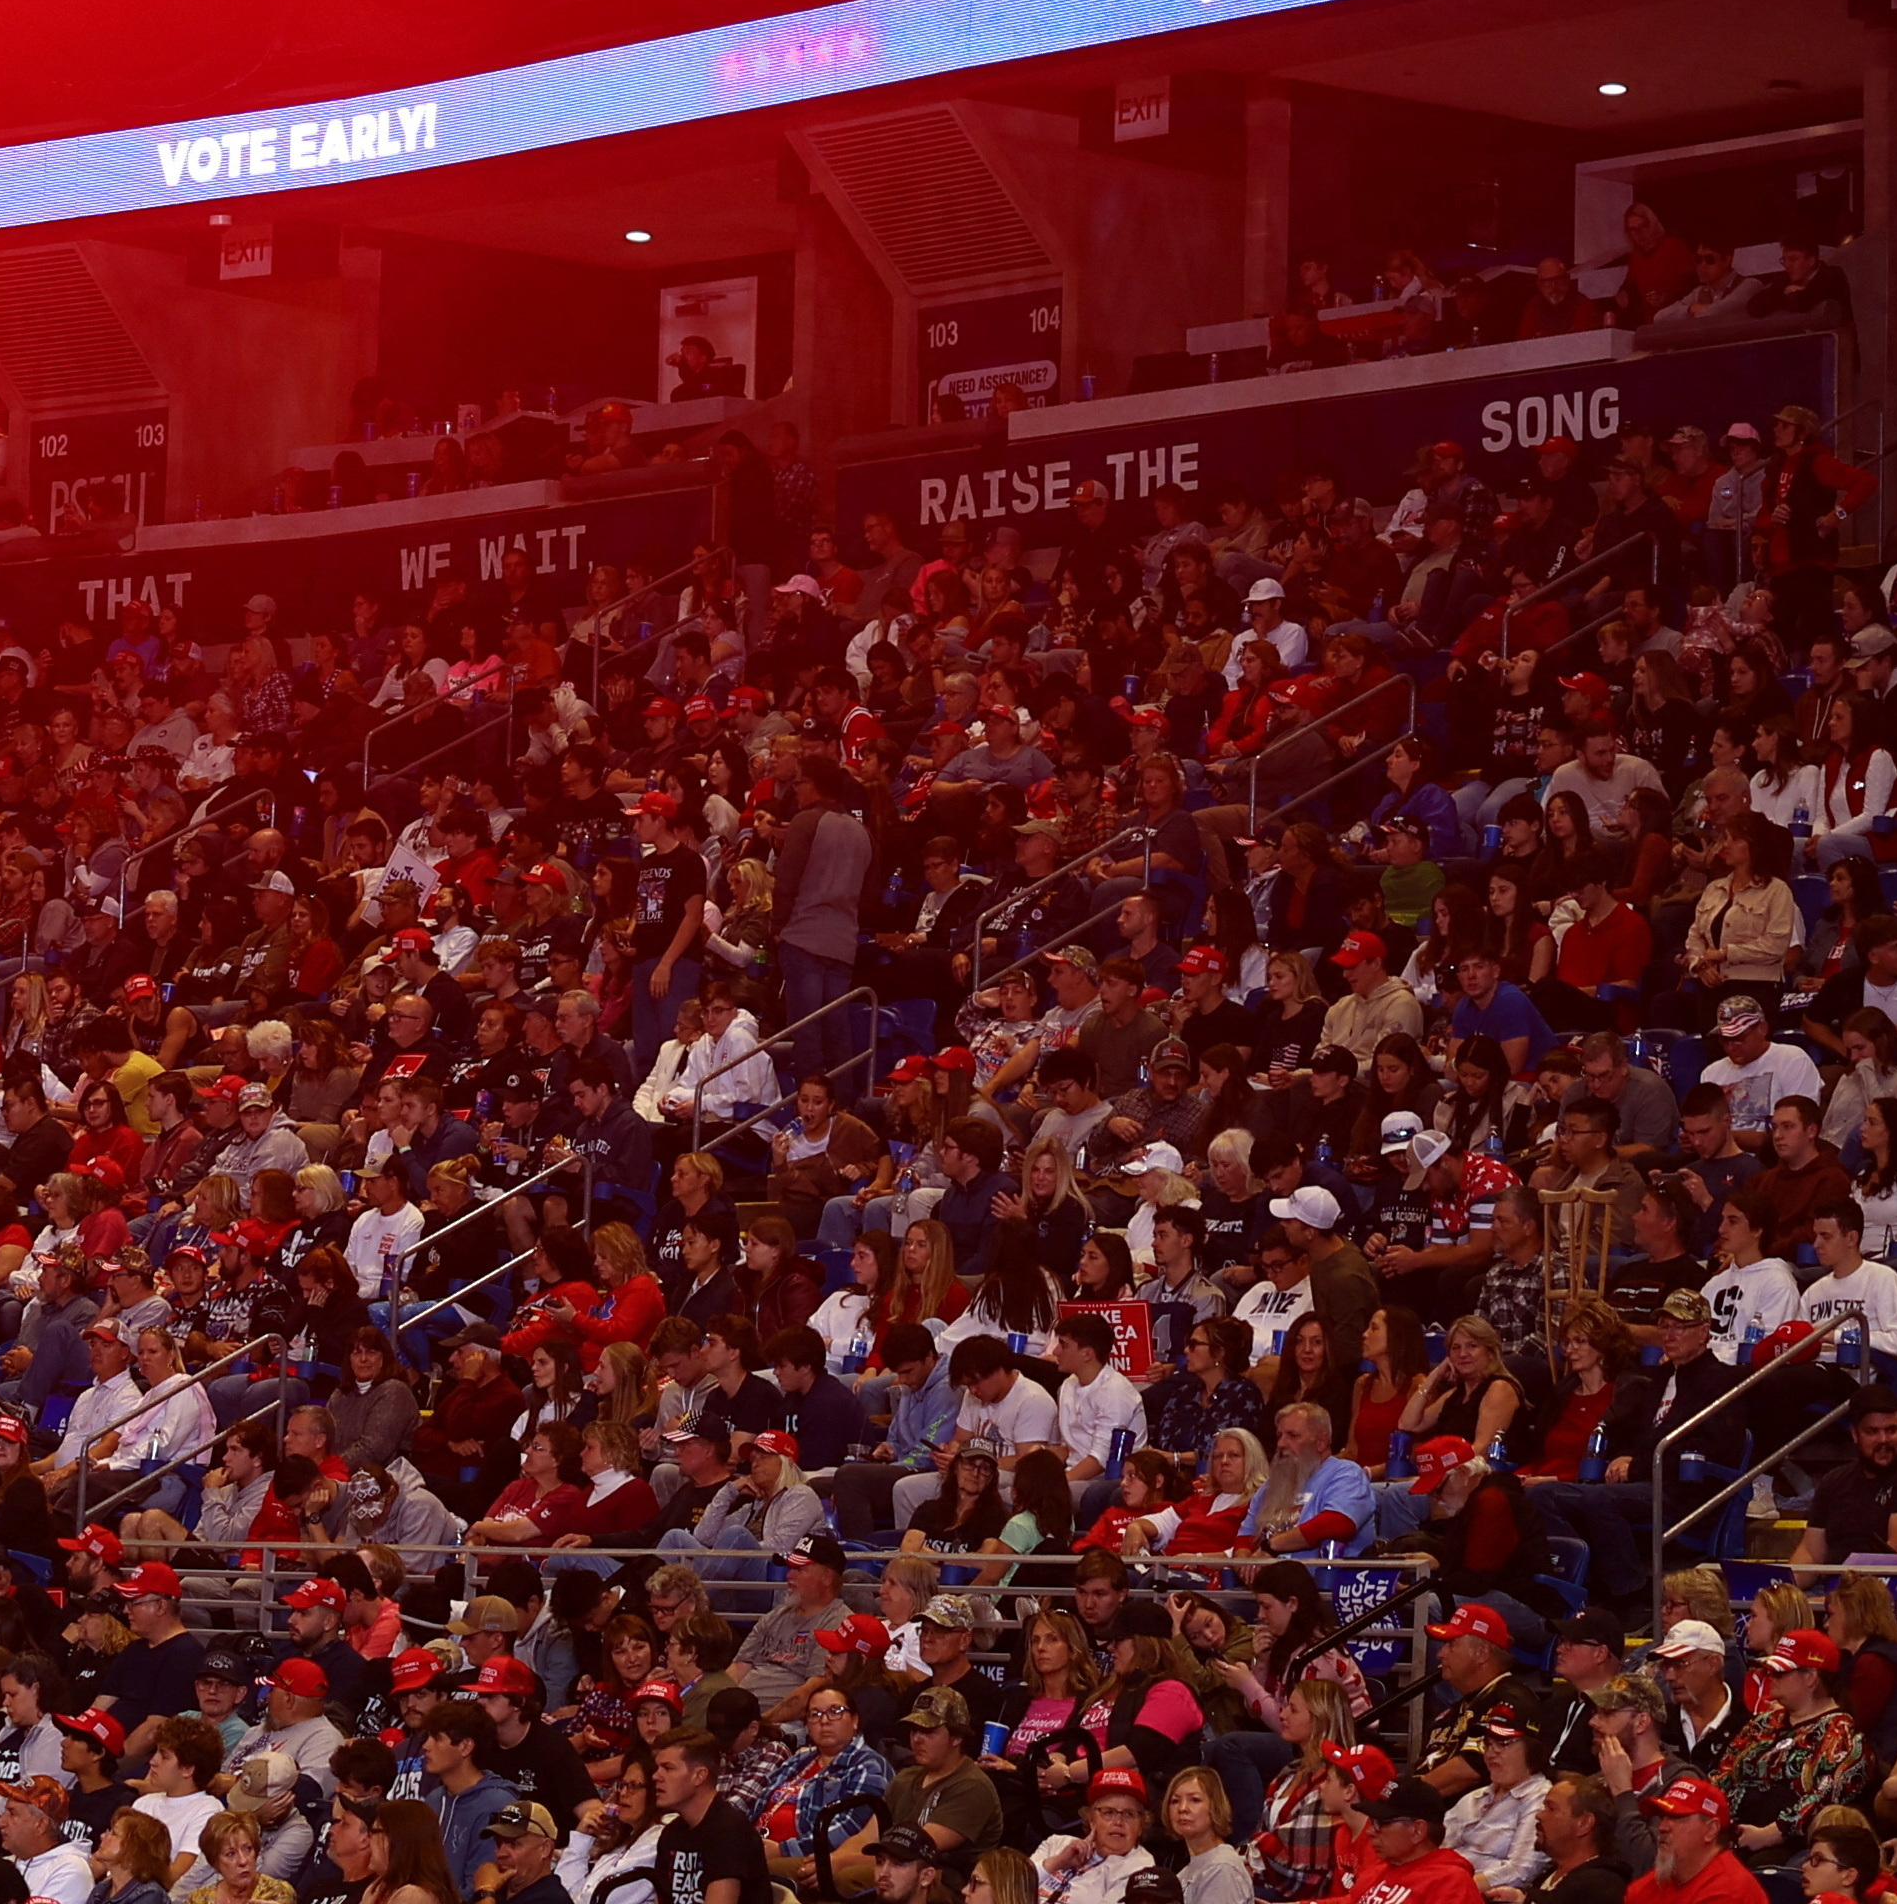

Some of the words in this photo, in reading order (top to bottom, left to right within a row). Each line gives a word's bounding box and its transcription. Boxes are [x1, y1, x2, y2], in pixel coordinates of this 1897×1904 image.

[1116, 94, 1166, 124] EXIT
[157, 127, 278, 187] VOTE
[289, 102, 439, 170] EARLY!
[223, 239, 270, 265] EXIT
[927, 320, 959, 348] 103
[1028, 305, 1060, 333] 104
[949, 378, 977, 395] NEED
[979, 367, 1050, 391] ASSISTANCE?
[38, 433, 69, 457] 102
[134, 423, 165, 449] 103
[1481, 386, 1620, 453] SONG
[918, 459, 1071, 526] RAISE
[1105, 442, 1199, 502] THE
[78, 572, 192, 622] THAT
